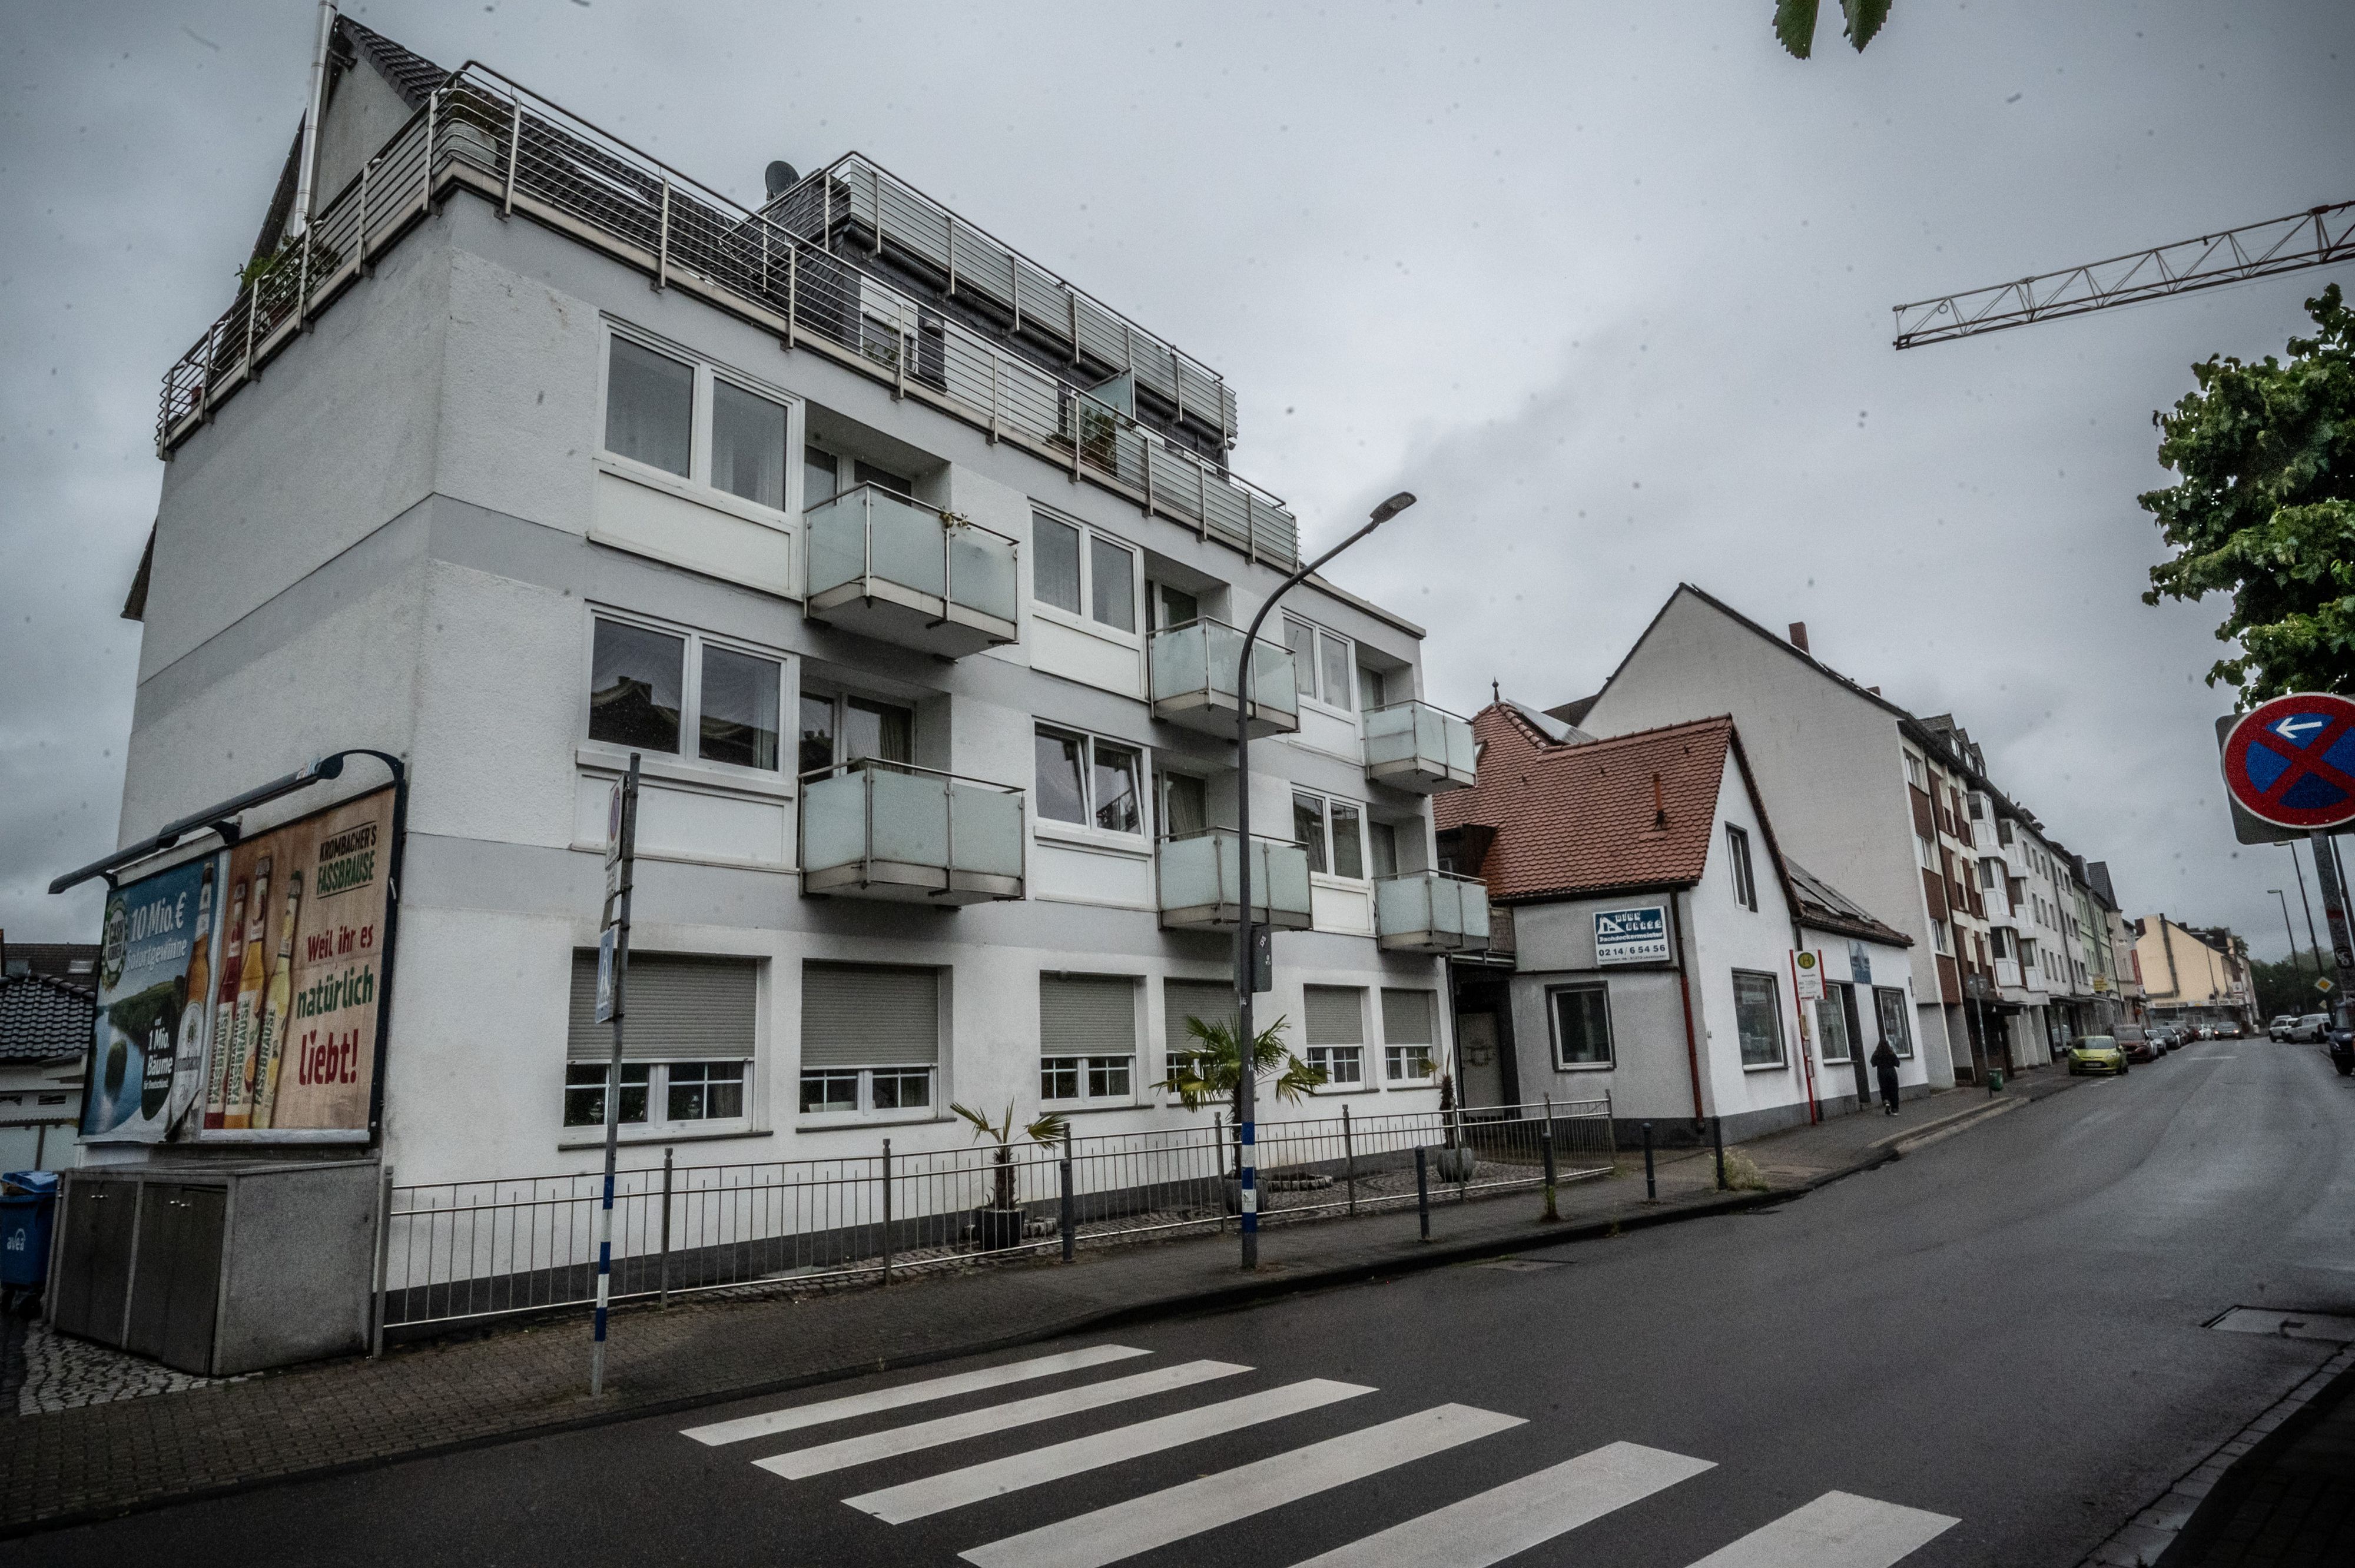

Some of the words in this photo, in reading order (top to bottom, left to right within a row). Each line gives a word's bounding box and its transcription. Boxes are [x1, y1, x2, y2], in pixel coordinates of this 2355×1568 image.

[320, 824, 377, 862] KROMBACHER'S
[317, 849, 375, 895] FASSBRAUSE
[131, 905, 147, 942] 10
[148, 897, 173, 938] Mio.
[176, 891, 187, 929] €
[1599, 932, 1663, 942] Dachdeckermeister
[127, 938, 187, 971] Sofortgewinne
[307, 929, 333, 962] Weil
[338, 925, 356, 955] ihr
[360, 924, 373, 949] es
[297, 964, 374, 1019] natürlich
[148, 1029, 153, 1051] 1
[154, 1027, 170, 1049] Mio.
[211, 1009, 230, 1104] FASSBRAUSE
[231, 999, 250, 1105] FASSBRAUSE
[254, 1008, 276, 1105] FASSBRAUSE
[298, 1028, 359, 1085] liebt!
[147, 1054, 173, 1076] Bäume
